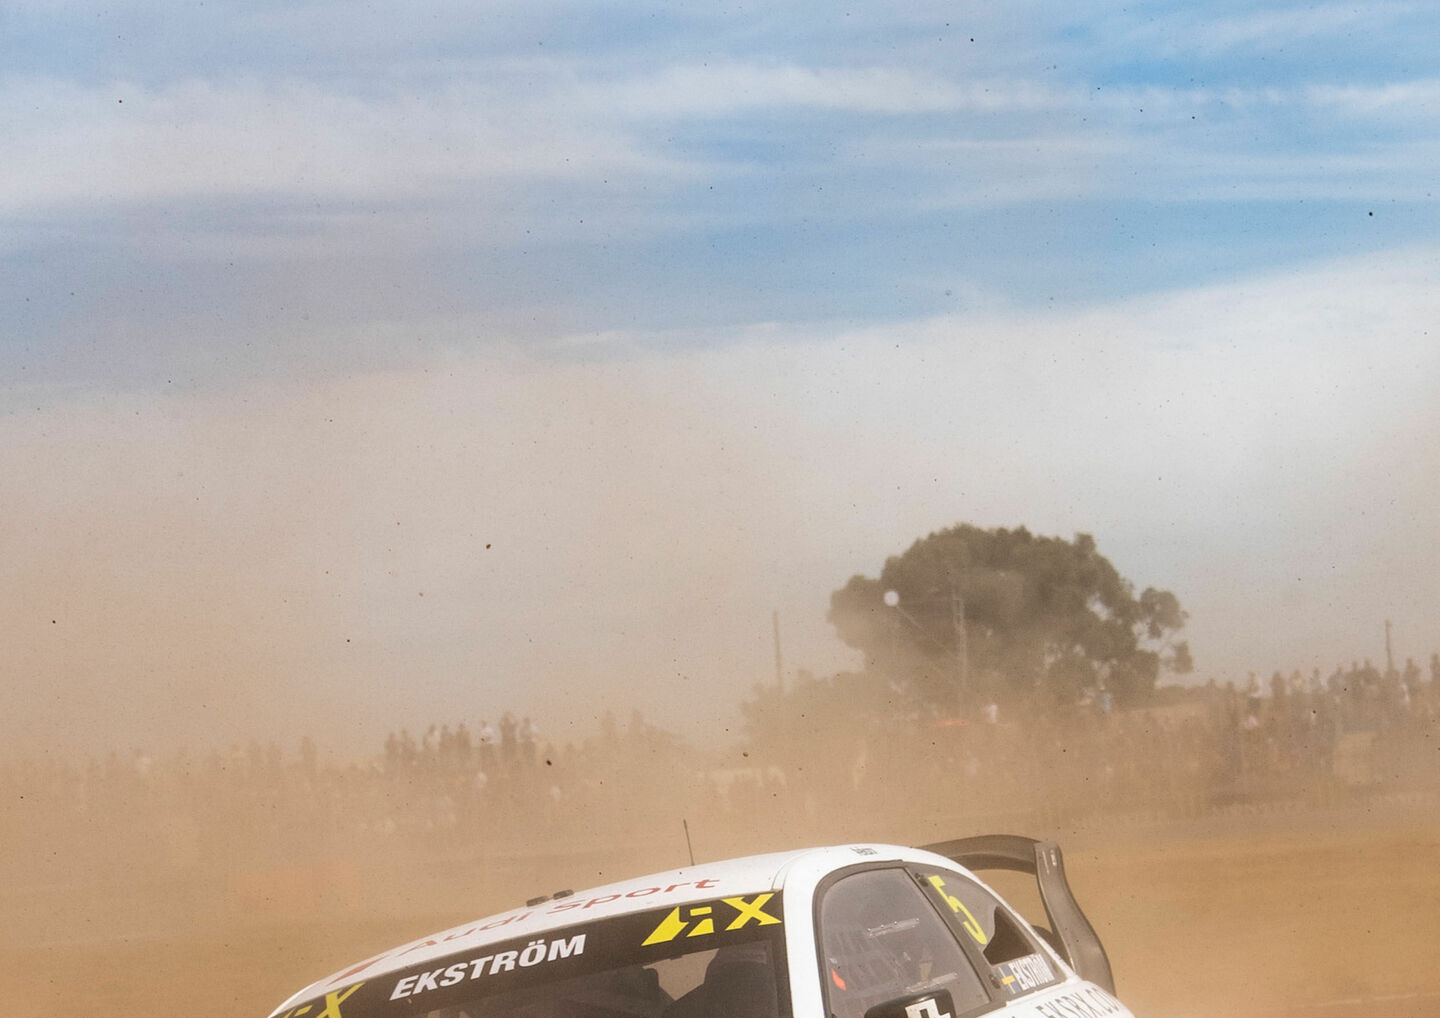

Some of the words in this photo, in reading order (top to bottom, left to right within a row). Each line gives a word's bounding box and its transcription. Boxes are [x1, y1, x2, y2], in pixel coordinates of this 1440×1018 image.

[399, 912, 527, 957] Audi
[554, 877, 721, 915] Sport
[928, 875, 988, 945] 5
[390, 934, 587, 1001] EKSTRÖM
